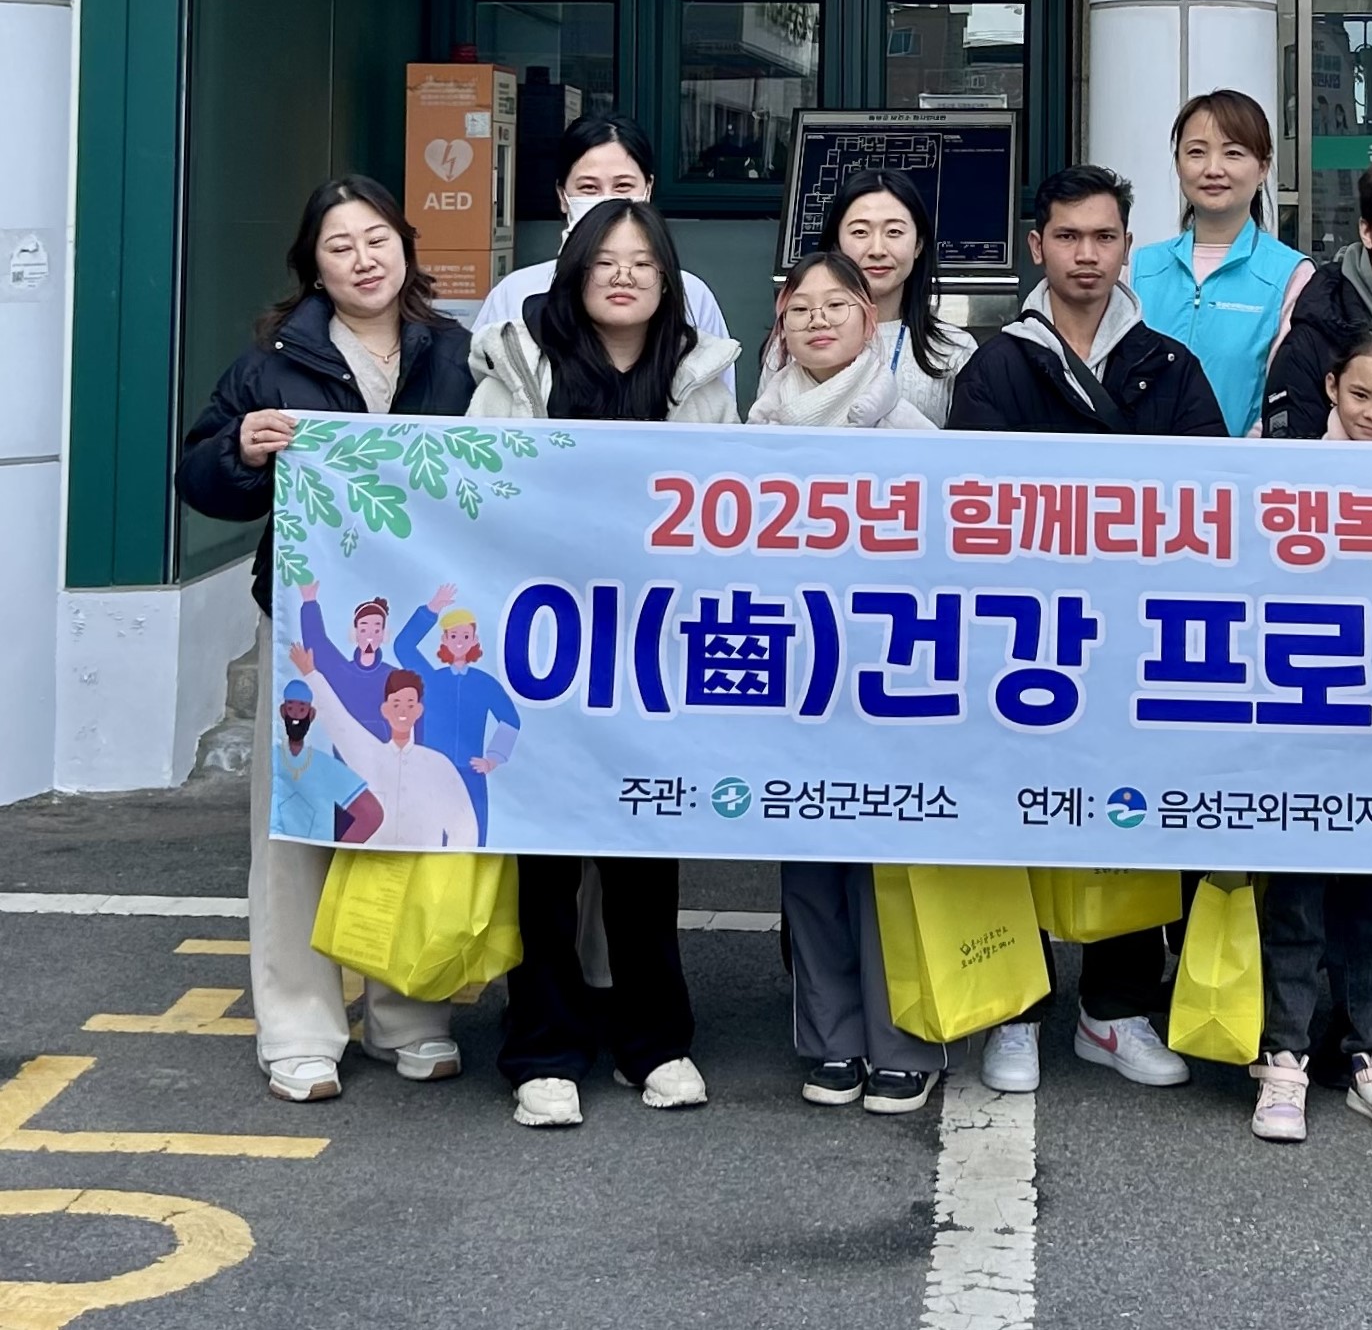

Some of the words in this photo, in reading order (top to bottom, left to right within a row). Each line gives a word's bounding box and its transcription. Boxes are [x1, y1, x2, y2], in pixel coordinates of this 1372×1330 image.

[424, 192, 472, 210] AED
[652, 478, 920, 551] 2025년
[951, 481, 1230, 559] 함께라서
[619, 777, 697, 816] 주관:
[760, 780, 959, 821] 음성군보건소
[1017, 787, 1094, 827] 연계:
